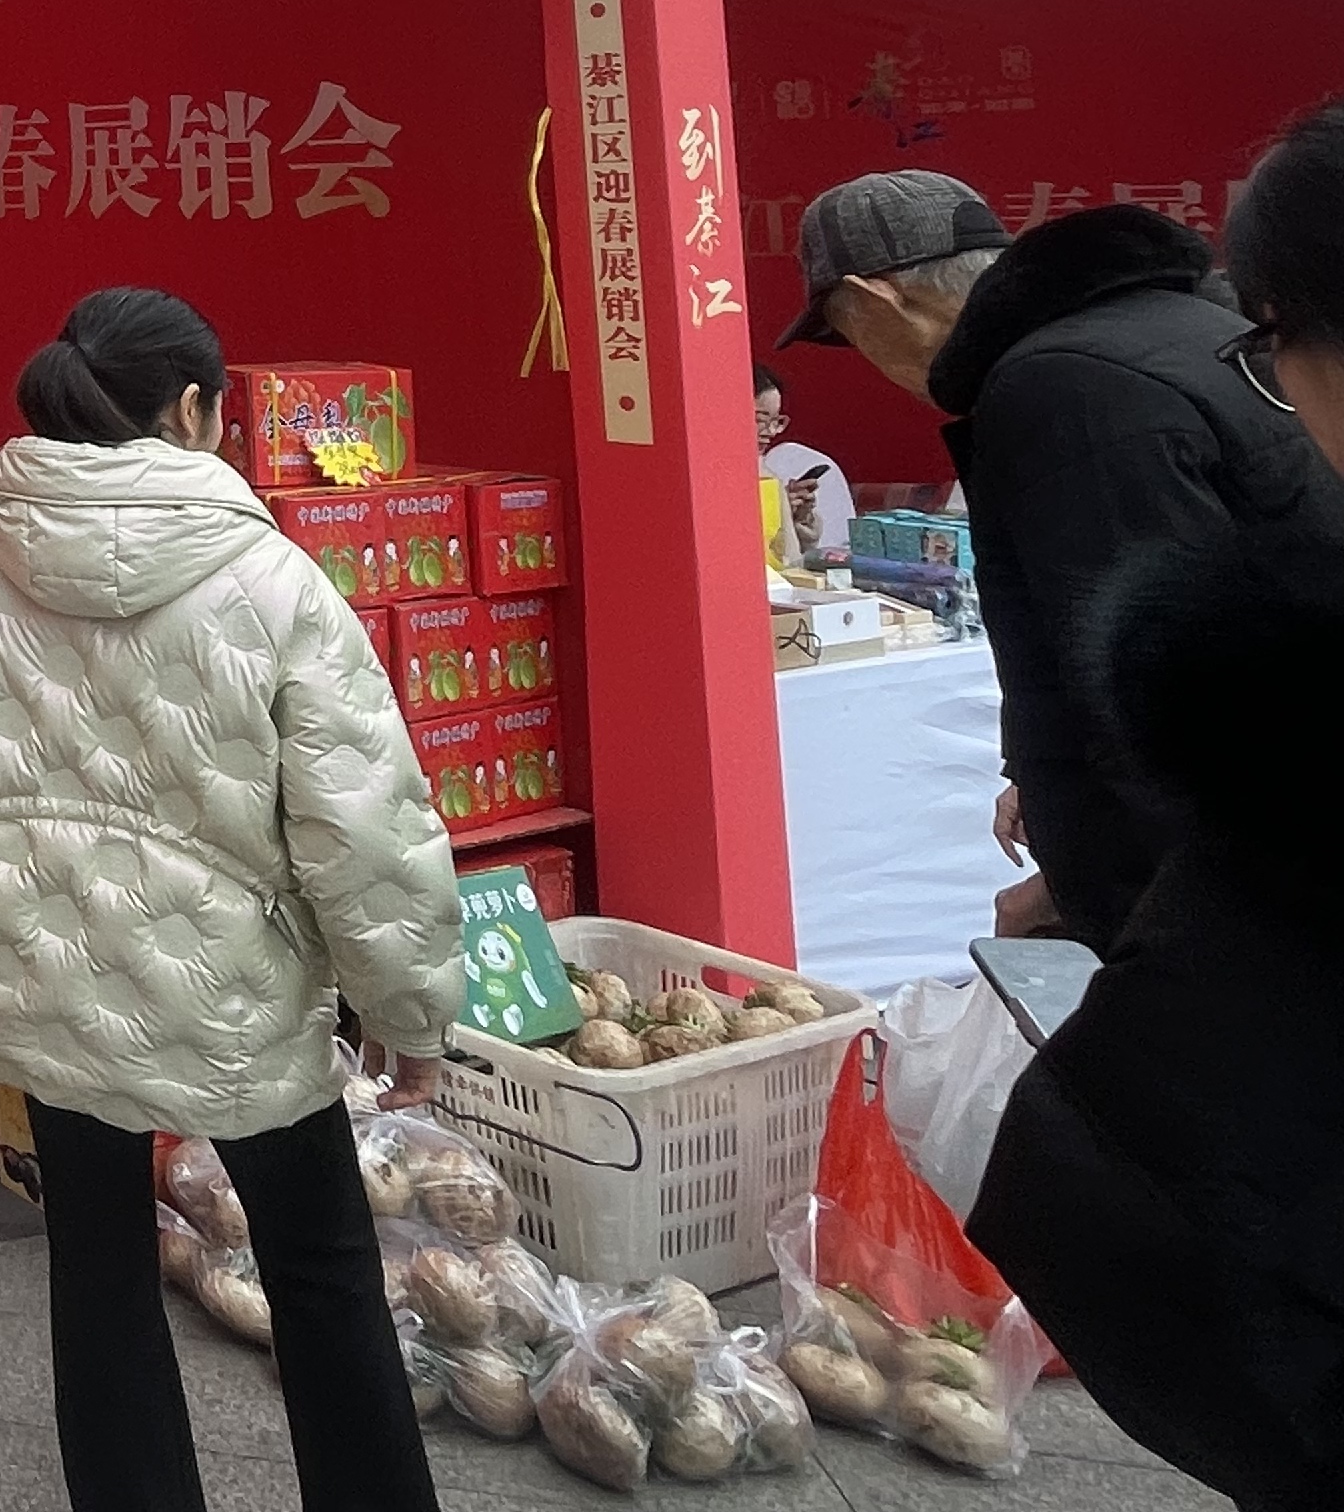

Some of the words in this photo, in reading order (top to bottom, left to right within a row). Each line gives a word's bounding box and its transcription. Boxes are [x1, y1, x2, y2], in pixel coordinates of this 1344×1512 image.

[583, 51, 645, 362] 綦江区迎春展销会
